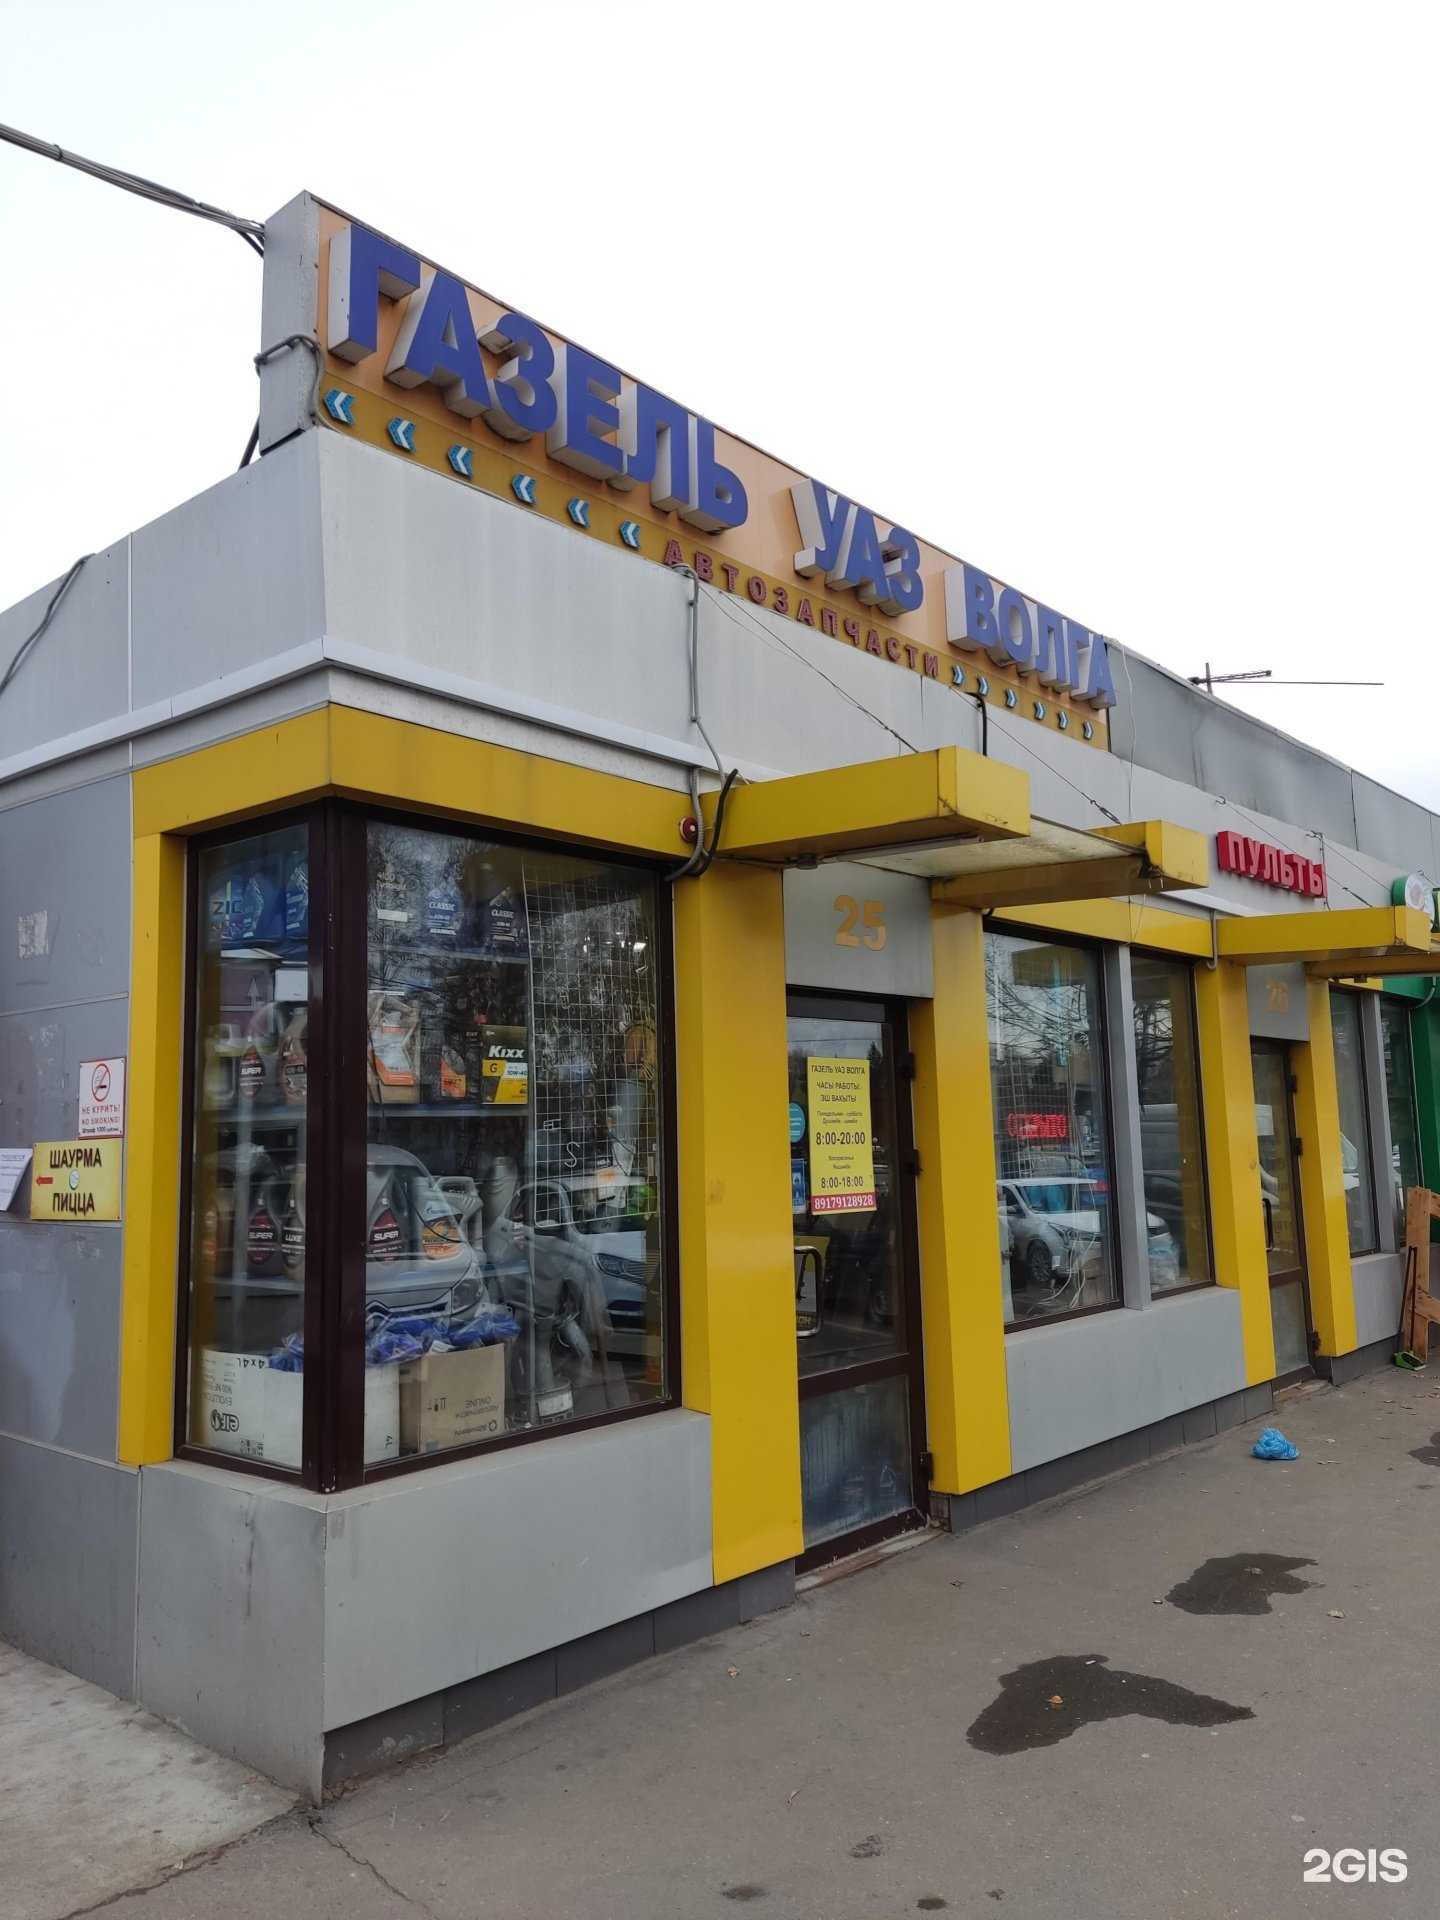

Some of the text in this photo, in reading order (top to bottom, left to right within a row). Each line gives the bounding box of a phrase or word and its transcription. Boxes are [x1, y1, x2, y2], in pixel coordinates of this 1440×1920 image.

[329, 224, 1117, 709] ГАЗЕЛЬ УАЗ ВОЛГА
[664, 538, 940, 678] АВТОЗАПЧАСТИ
[1217, 831, 1328, 898] ПУЛЬТЫ
[833, 895, 887, 951] 25
[490, 1063, 498, 1072] G
[811, 1065, 866, 1075] ГАЗЕЛЬ УАЗ ВОЛГА
[816, 1081, 833, 1089] ЧАСЫ
[816, 1132, 866, 1145] 8:00-20:00
[50, 1148, 102, 1168] ШАУРМА
[821, 1176, 864, 1188] 8:00-18:00
[52, 1192, 95, 1216] ПИЦЦА
[815, 1194, 873, 1210] 89179128928
[374, 1230, 399, 1241] SUPER
